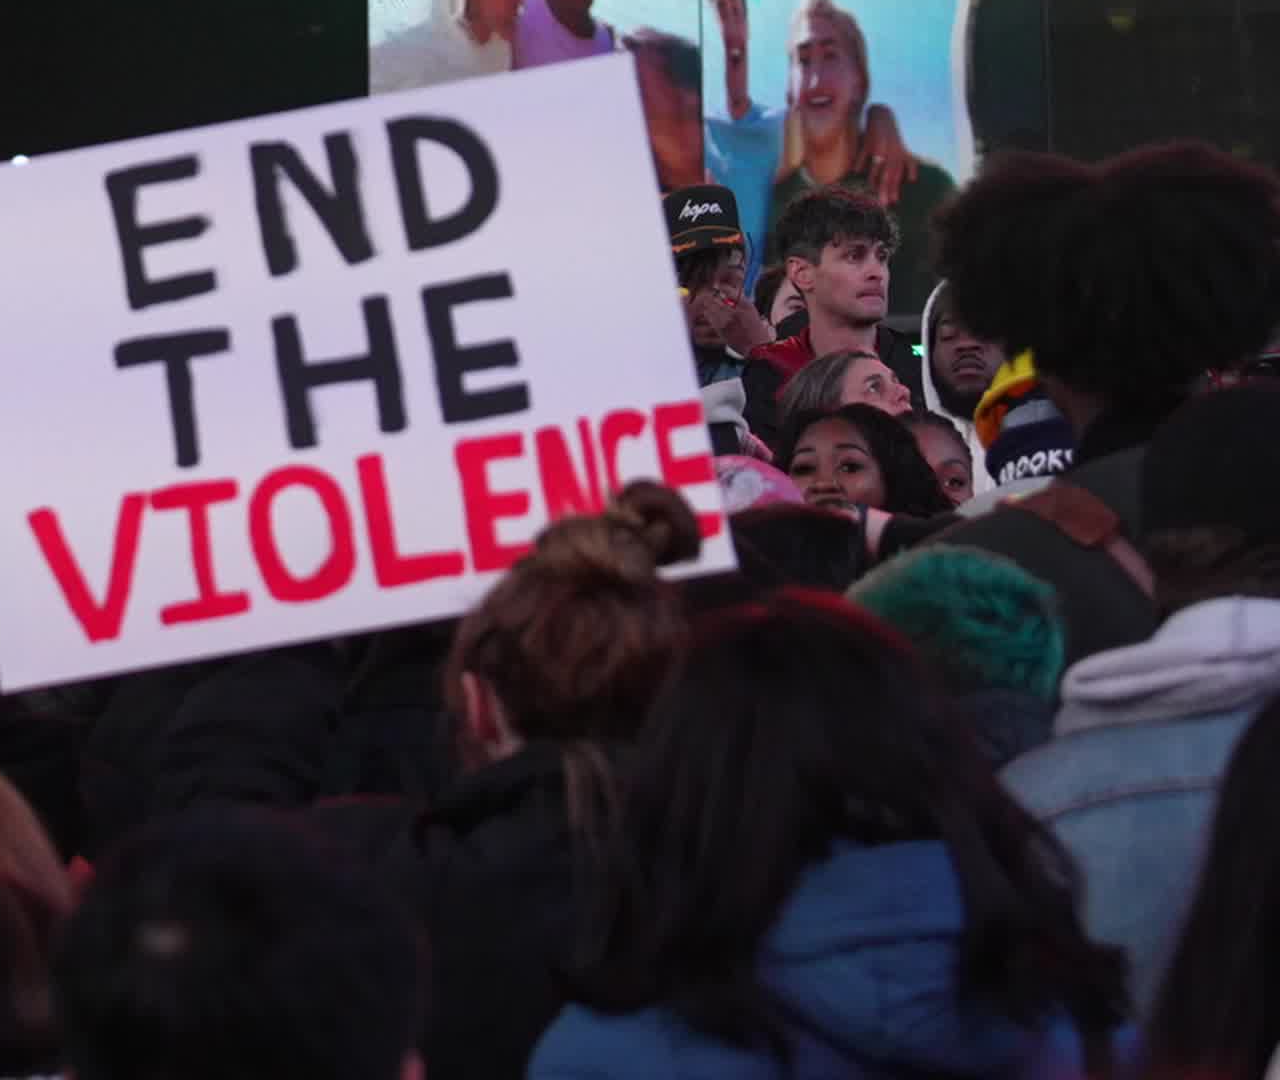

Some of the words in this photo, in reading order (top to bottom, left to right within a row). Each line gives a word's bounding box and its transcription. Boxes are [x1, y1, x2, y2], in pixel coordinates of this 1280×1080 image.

[104, 115, 500, 310] END
[114, 272, 530, 468] THE
[27, 400, 722, 644] VIOLENCE
